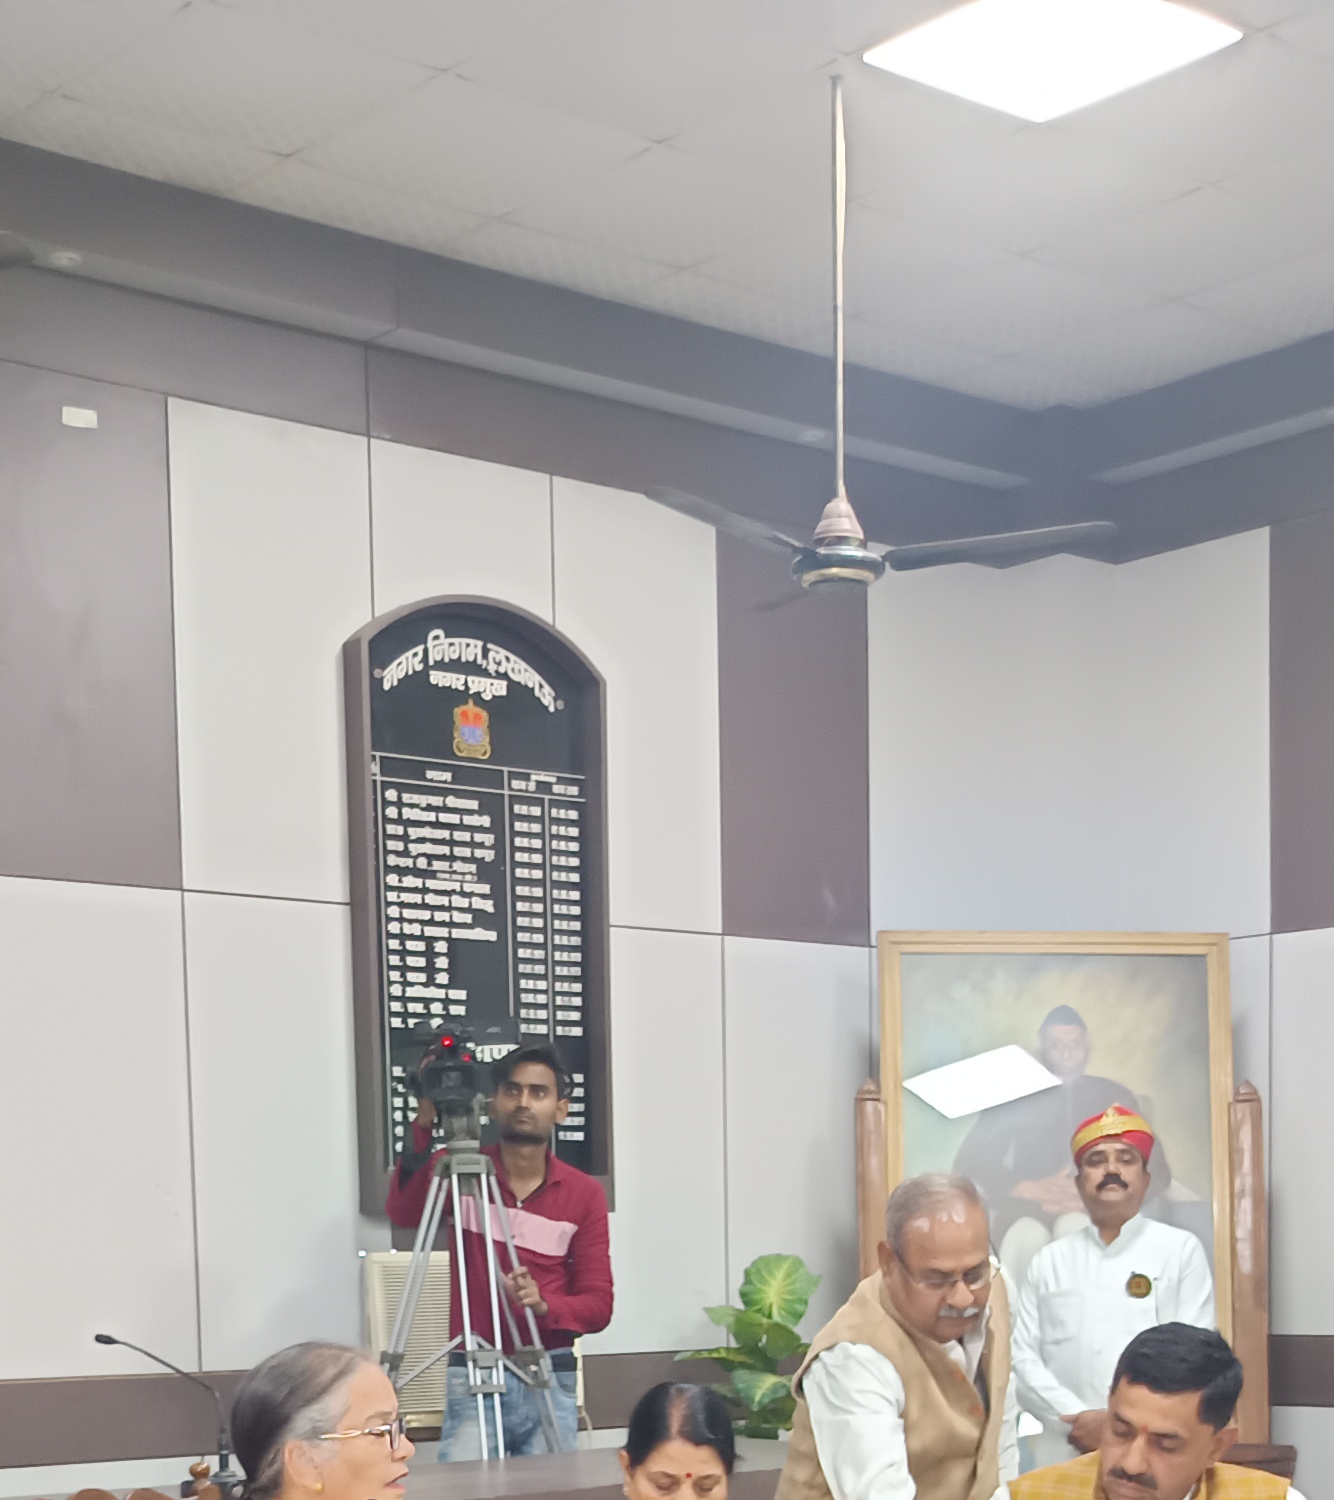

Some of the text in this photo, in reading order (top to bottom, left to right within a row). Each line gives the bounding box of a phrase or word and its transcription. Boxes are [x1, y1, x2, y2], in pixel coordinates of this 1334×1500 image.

[383, 644, 425, 691] नगर
[487, 643, 555, 712] लखनऊ
[429, 670, 466, 691] नगर
